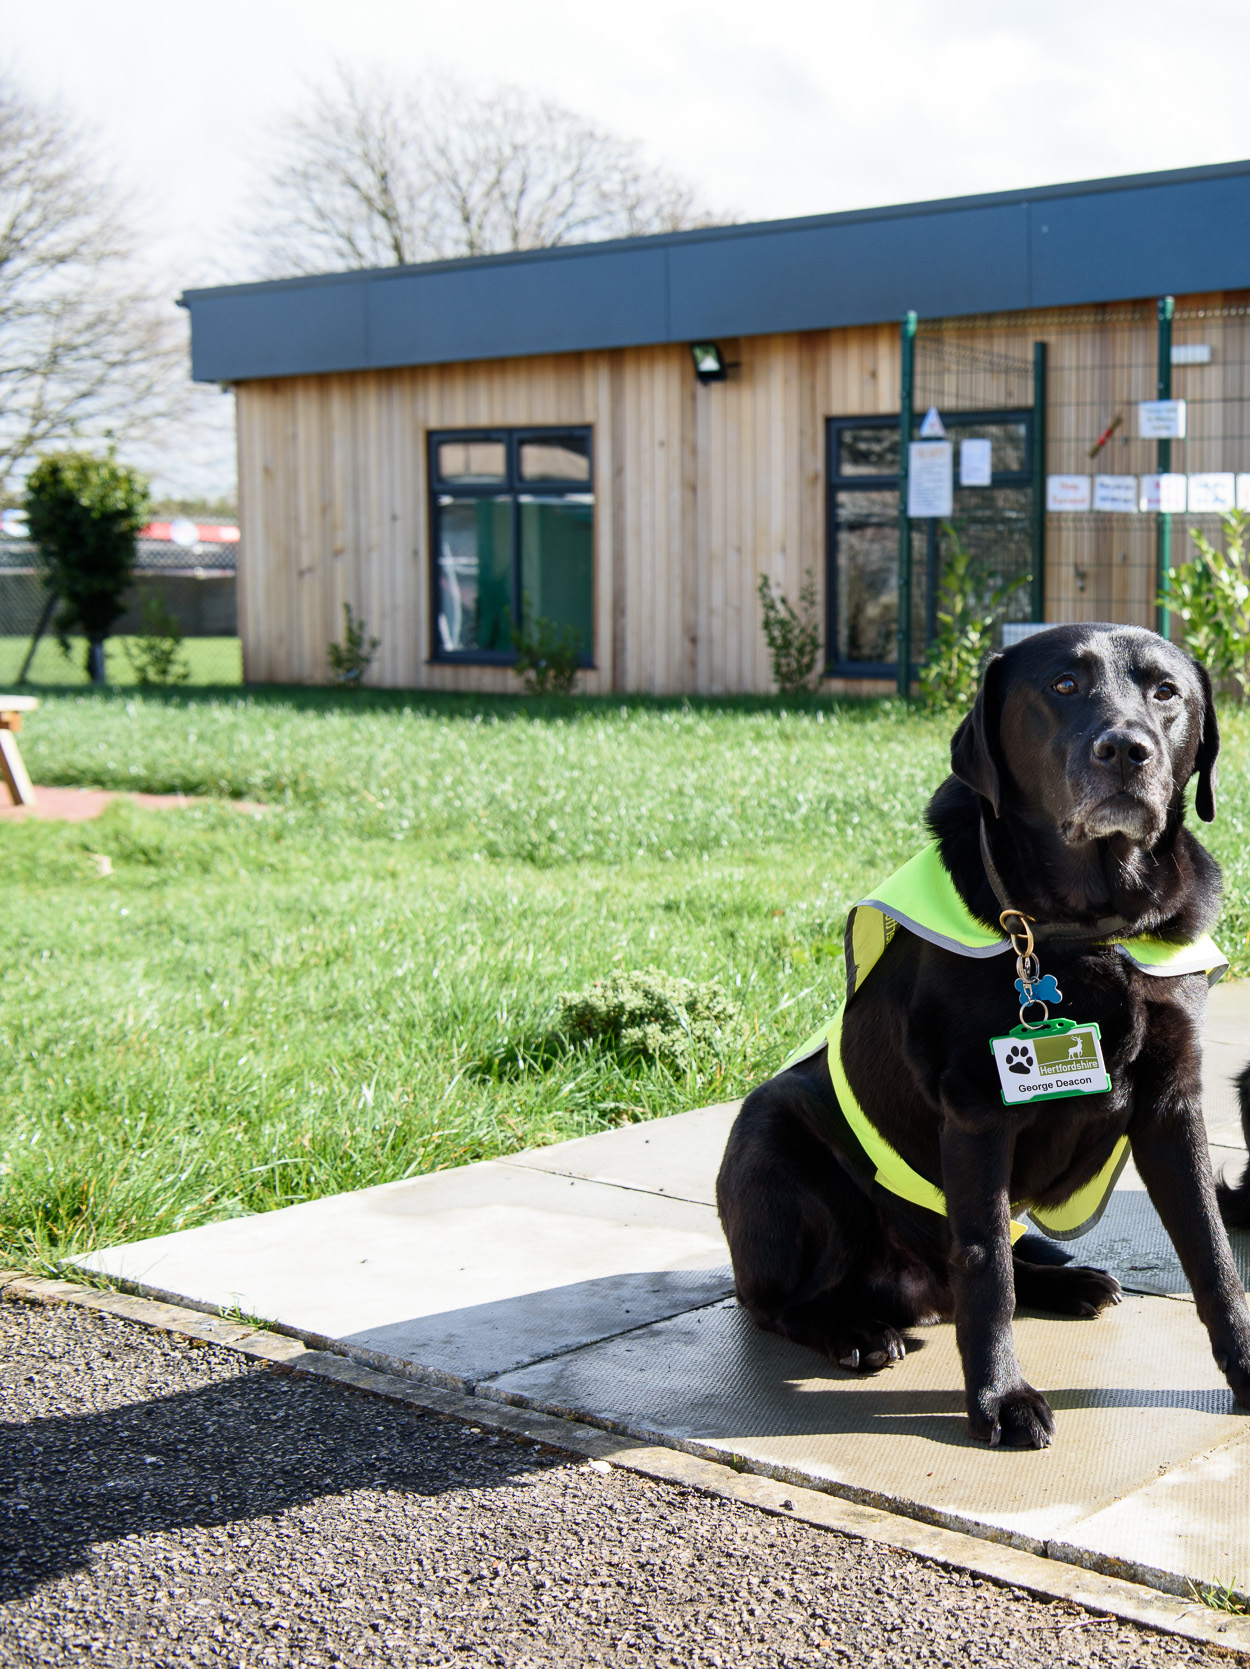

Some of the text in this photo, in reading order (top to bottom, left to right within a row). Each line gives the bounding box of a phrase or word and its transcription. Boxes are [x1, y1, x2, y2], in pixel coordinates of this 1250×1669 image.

[1040, 1060, 1097, 1075] Hertfordshire
[1018, 1077, 1092, 1093] George Deacon
